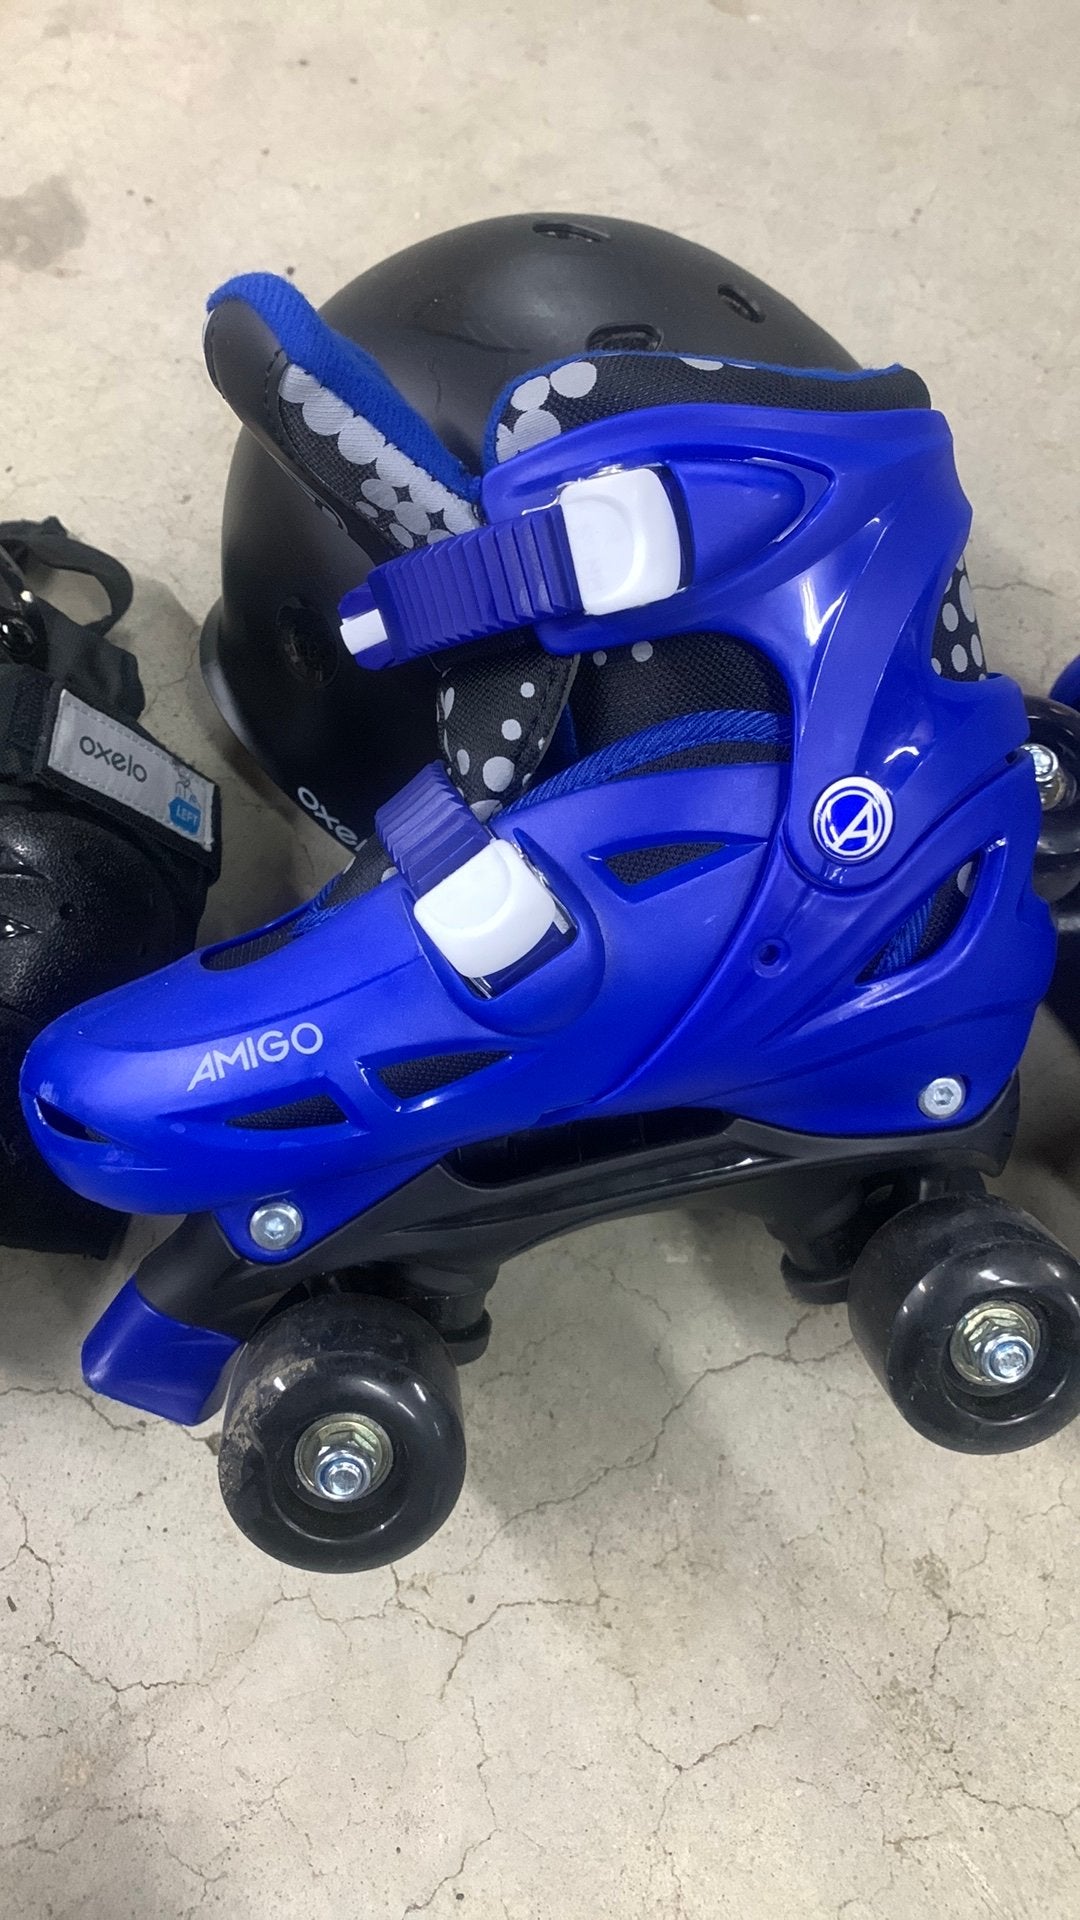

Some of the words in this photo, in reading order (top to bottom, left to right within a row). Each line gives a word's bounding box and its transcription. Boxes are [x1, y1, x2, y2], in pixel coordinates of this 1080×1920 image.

[79, 735, 148, 783] oxelo
[176, 804, 198, 826] LEFT
[297, 786, 368, 852] oxel
[187, 1022, 323, 1092] AMIGO
